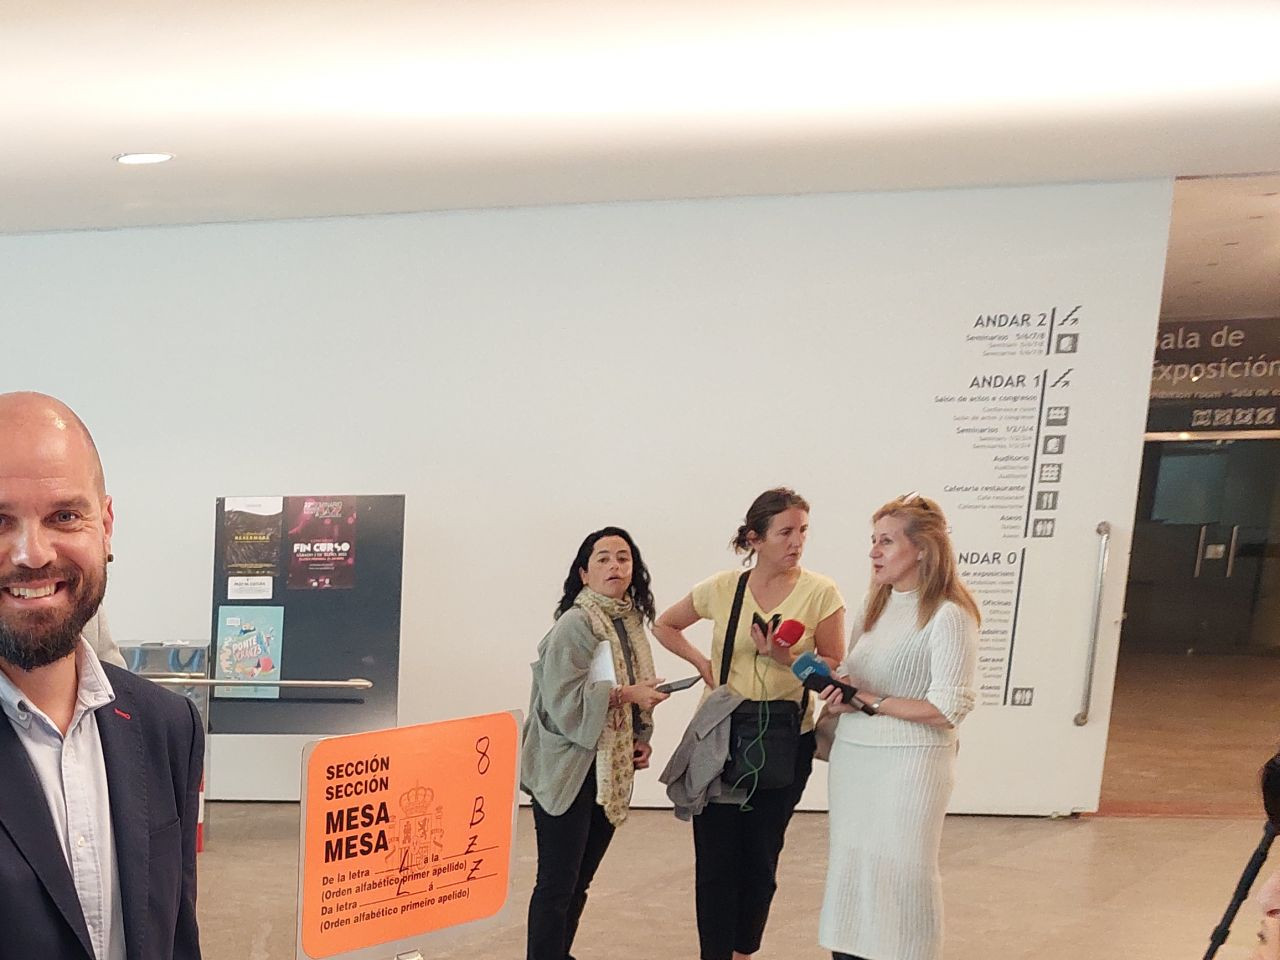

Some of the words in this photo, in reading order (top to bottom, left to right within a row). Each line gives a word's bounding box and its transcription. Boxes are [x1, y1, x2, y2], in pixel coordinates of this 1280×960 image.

[973, 313, 1031, 328] ANDAR
[1037, 312, 1047, 327] 2
[1160, 327, 1200, 350] ala
[1211, 326, 1245, 348] de
[969, 374, 1026, 388] ANDAR
[1033, 374, 1040, 388] 1
[1153, 354, 1280, 386] xposición
[293, 543, 311, 553] FIN
[313, 542, 350, 552] CURSO
[958, 552, 1001, 564] NDAR
[326, 754, 390, 780] SECCIÓN
[475, 736, 490, 775] 8
[325, 774, 389, 801] SECCIÓN
[325, 802, 390, 835] MESA
[470, 796, 485, 829] B
[324, 830, 389, 863] MESA
[321, 886, 352, 903] (Orden
[355, 876, 399, 895] alfabético
[402, 869, 430, 885] primer
[432, 859, 467, 880] apellido)
[322, 875, 335, 886] De
[337, 872, 346, 883] la
[348, 868, 370, 881] letra
[423, 856, 429, 864] a
[432, 852, 439, 863] la
[320, 916, 351, 933] (Orden
[353, 905, 398, 925] alfabético
[400, 897, 435, 915] primeiro
[438, 888, 470, 905] apelido)
[321, 905, 333, 916] Da
[336, 900, 357, 913] letra
